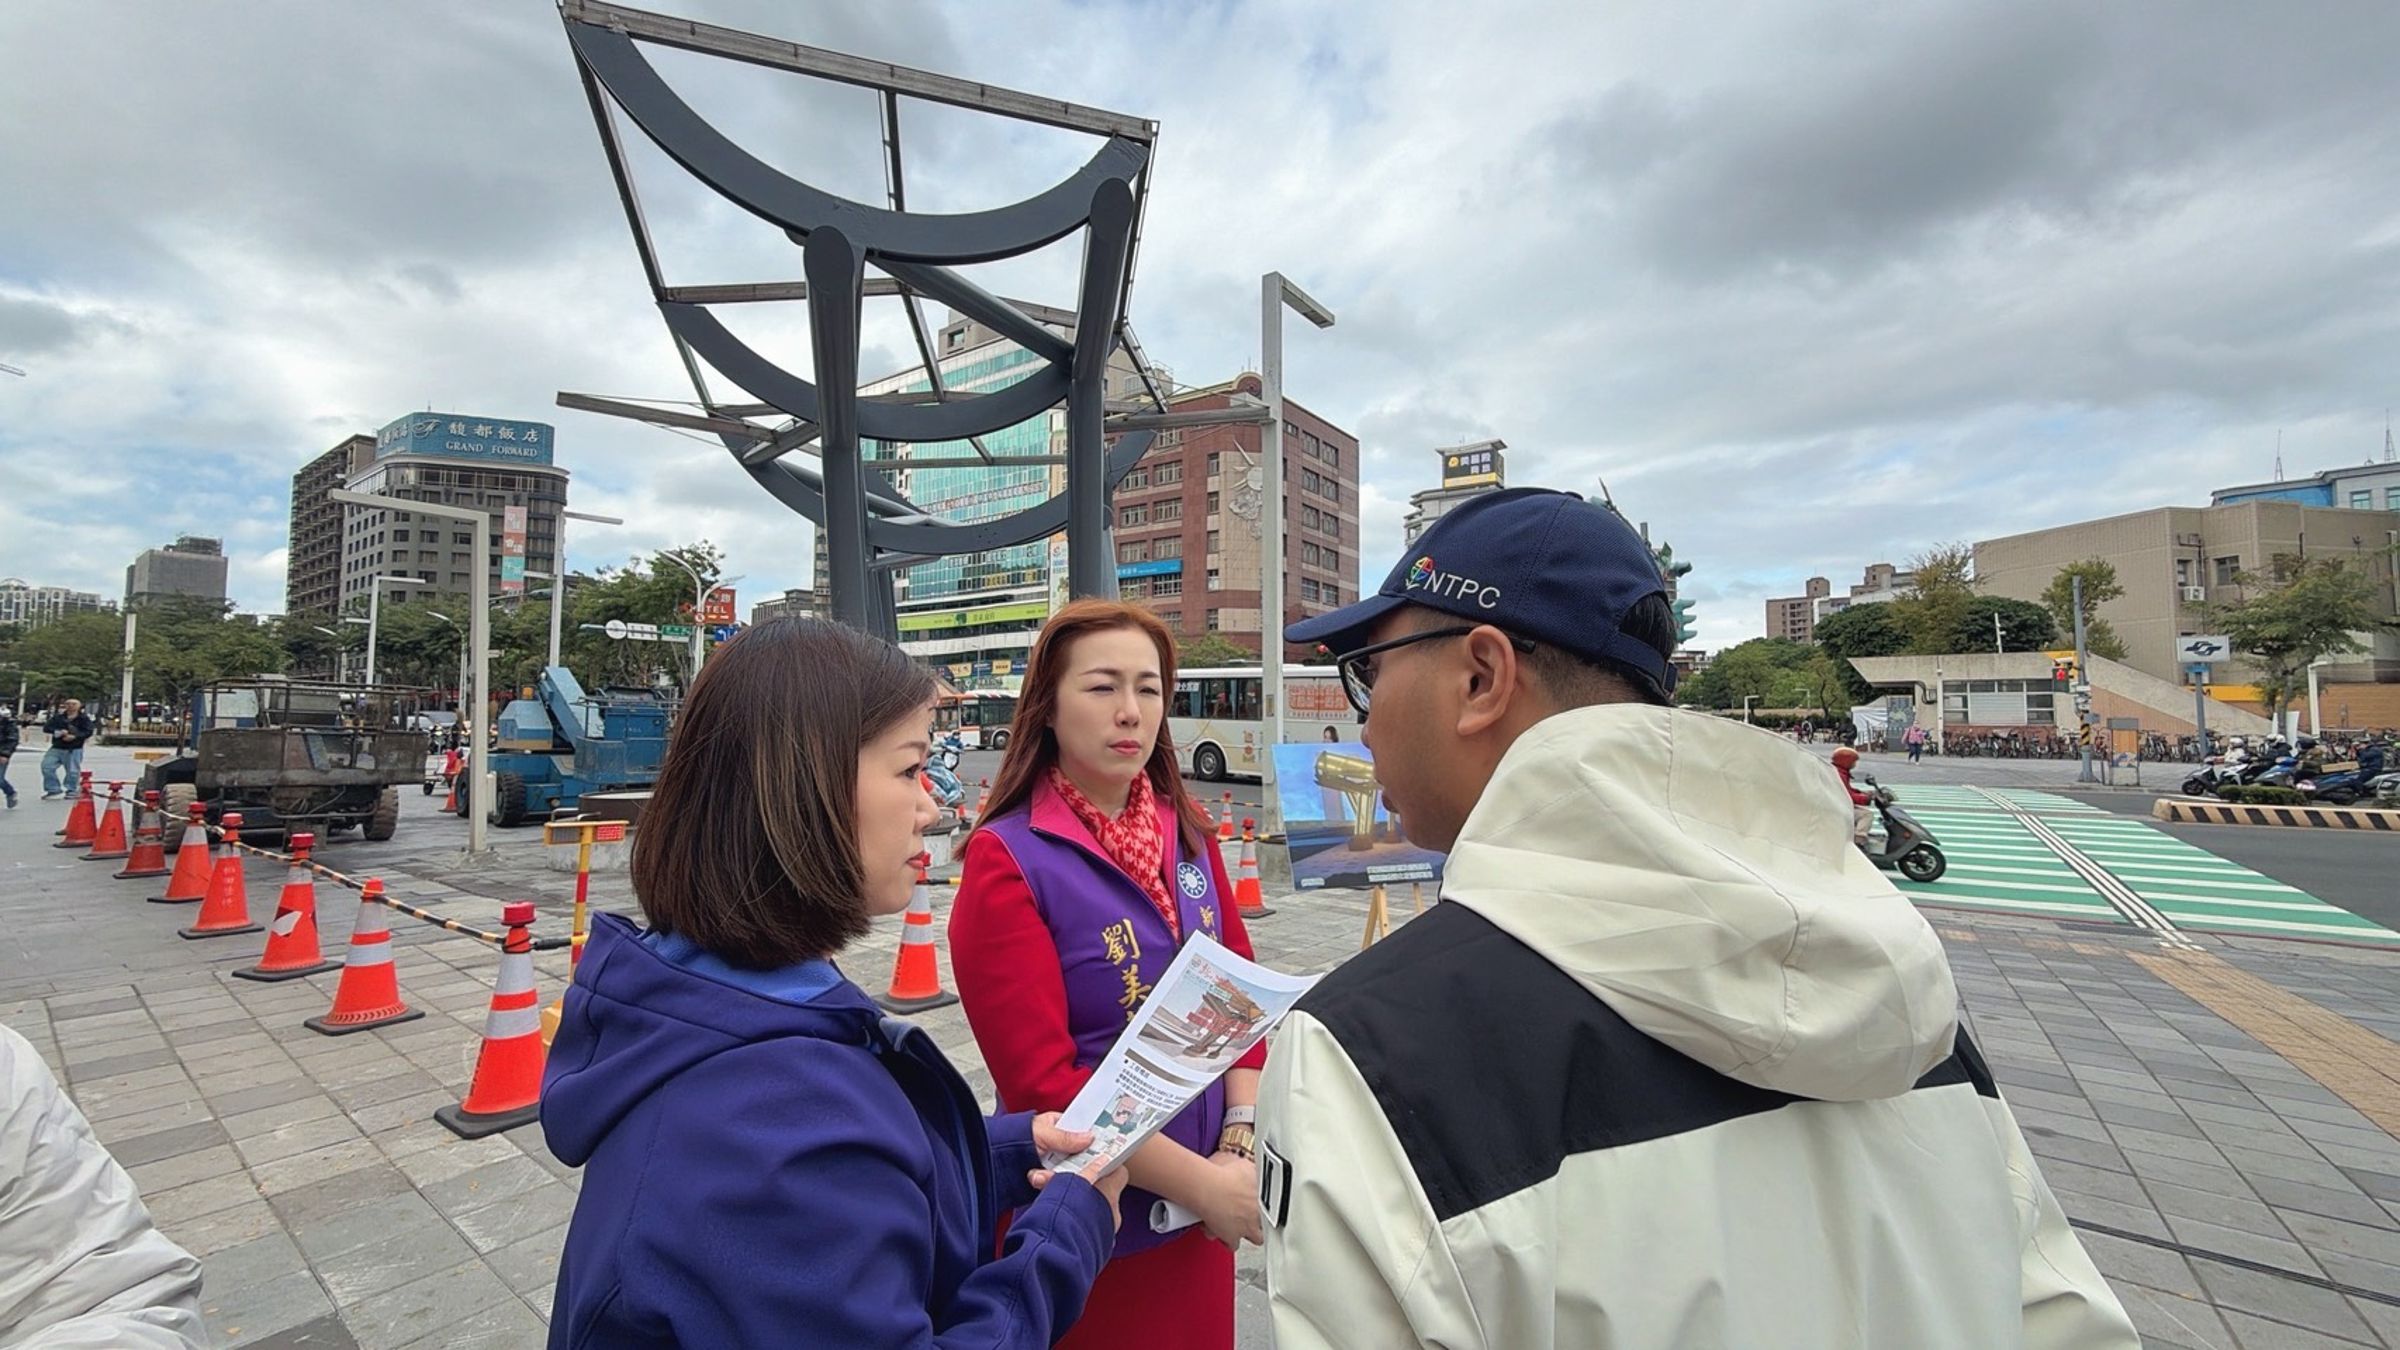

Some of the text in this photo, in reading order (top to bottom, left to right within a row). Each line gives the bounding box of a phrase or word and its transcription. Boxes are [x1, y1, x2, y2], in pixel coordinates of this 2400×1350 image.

[450, 421, 539, 443] 馥都飯店
[445, 441, 538, 458] GRAND FORWARD
[1423, 569, 1501, 609] NTPC
[1101, 918, 1152, 1022] 劉美
